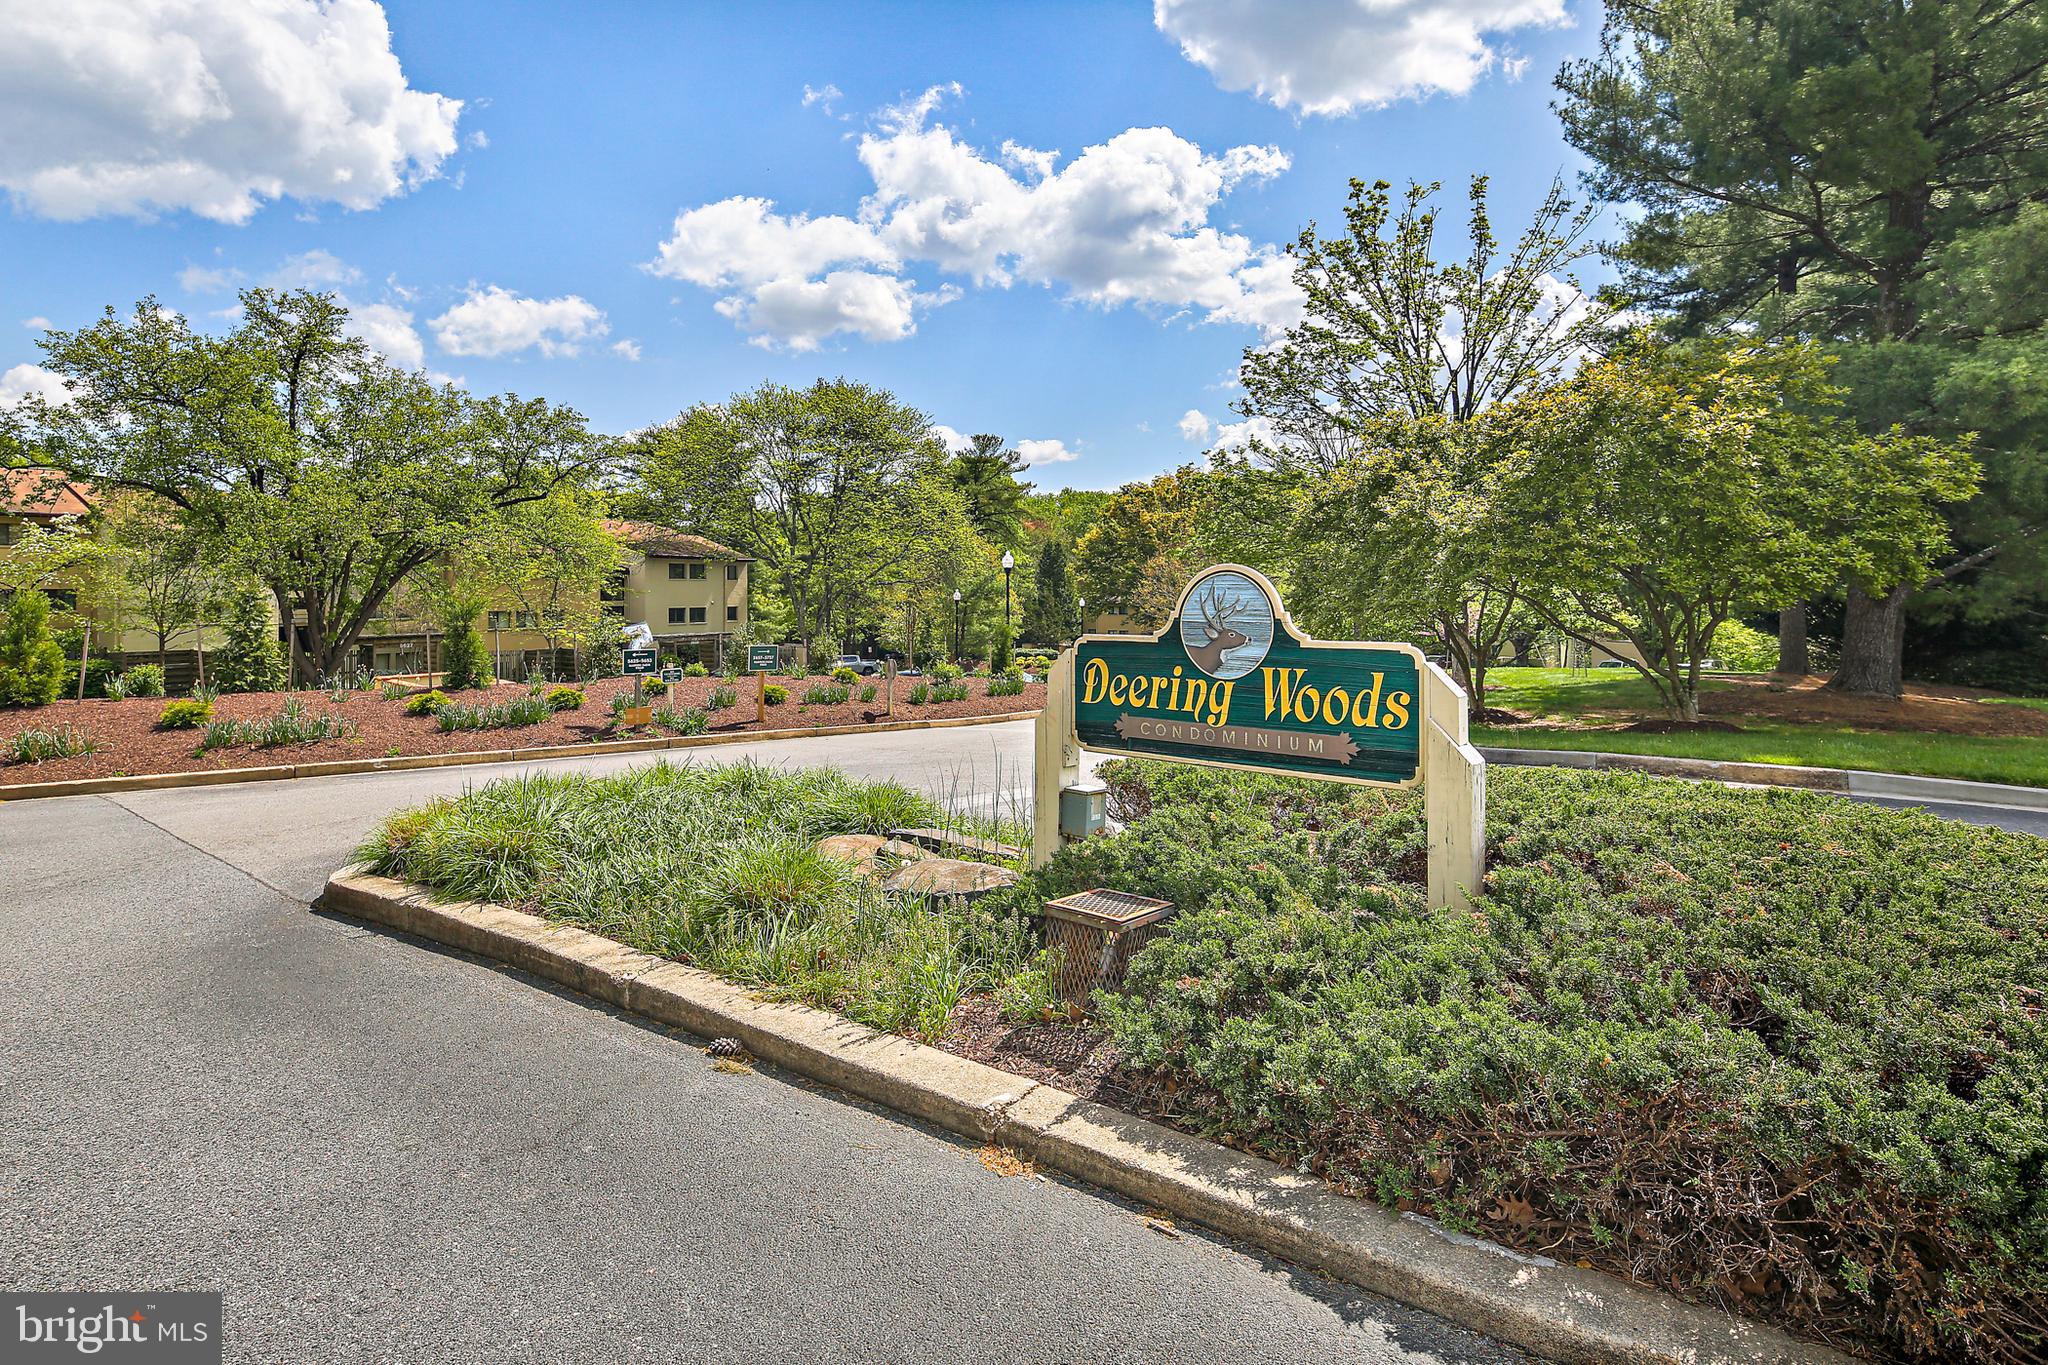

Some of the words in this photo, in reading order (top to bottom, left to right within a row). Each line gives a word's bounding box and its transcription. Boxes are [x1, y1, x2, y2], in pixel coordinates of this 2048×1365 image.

[1080, 657, 1236, 728] Deering
[1259, 667, 1411, 730] Woods
[1139, 721, 1325, 754] CONDOMINIUM
